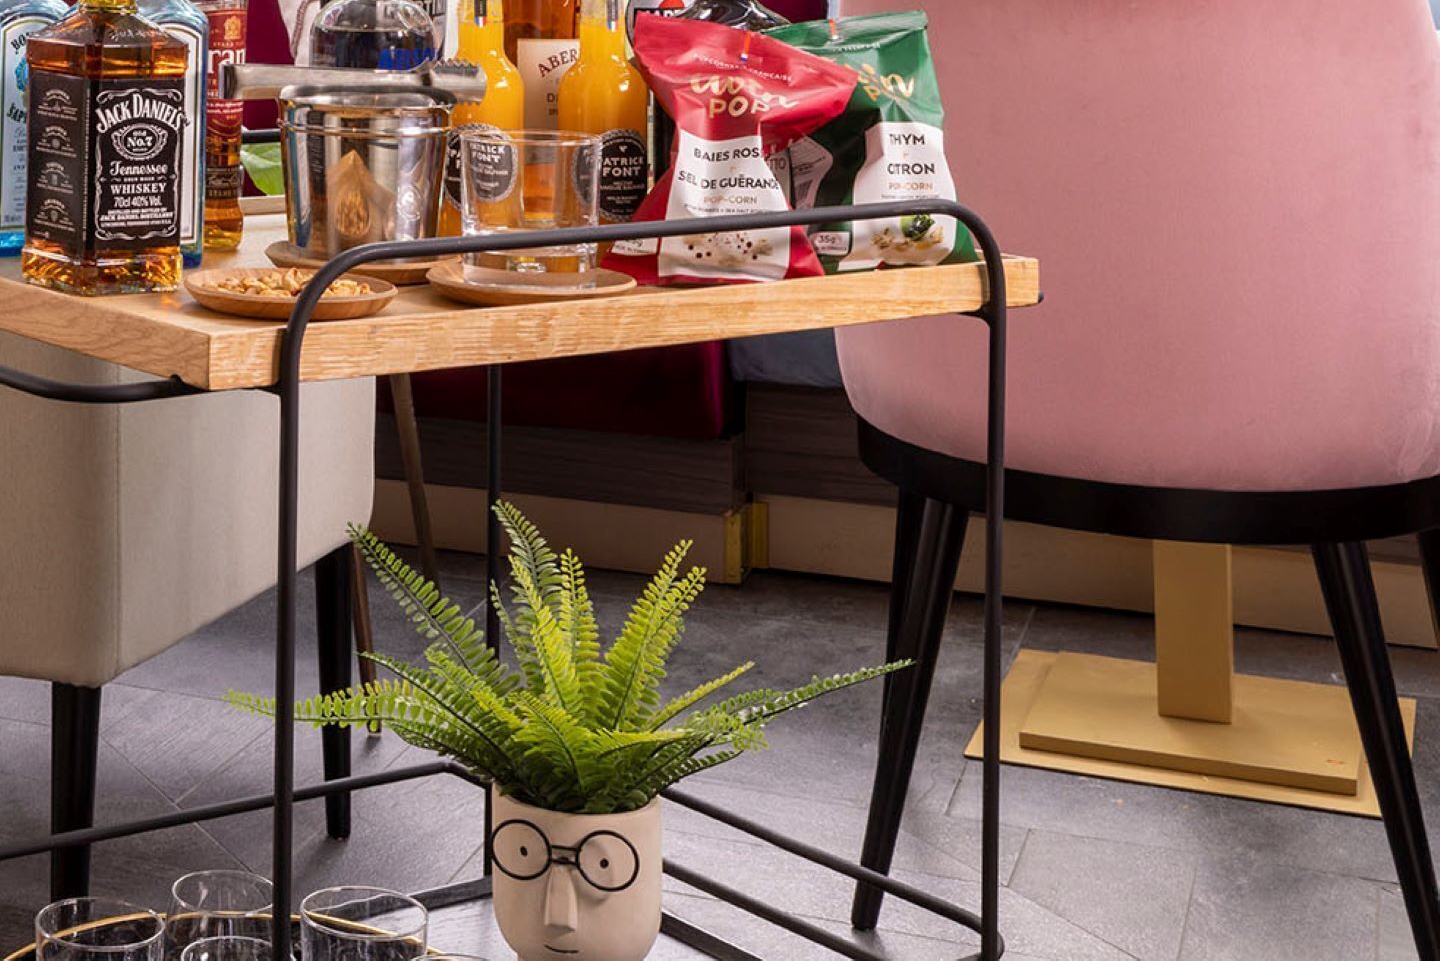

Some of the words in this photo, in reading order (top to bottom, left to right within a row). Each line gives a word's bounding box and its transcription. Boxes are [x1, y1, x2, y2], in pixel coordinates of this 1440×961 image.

[538, 48, 577, 77] ABER
[708, 96, 770, 119] POP
[95, 101, 132, 133] JACK
[889, 134, 926, 145] THYM
[694, 149, 729, 159] BAIES
[110, 160, 168, 175] Tennessee
[602, 167, 642, 177] FONT
[678, 170, 698, 185] SEL
[701, 179, 717, 189] DE
[110, 182, 167, 194] WHISKEY
[703, 195, 758, 204] POP-CORN
